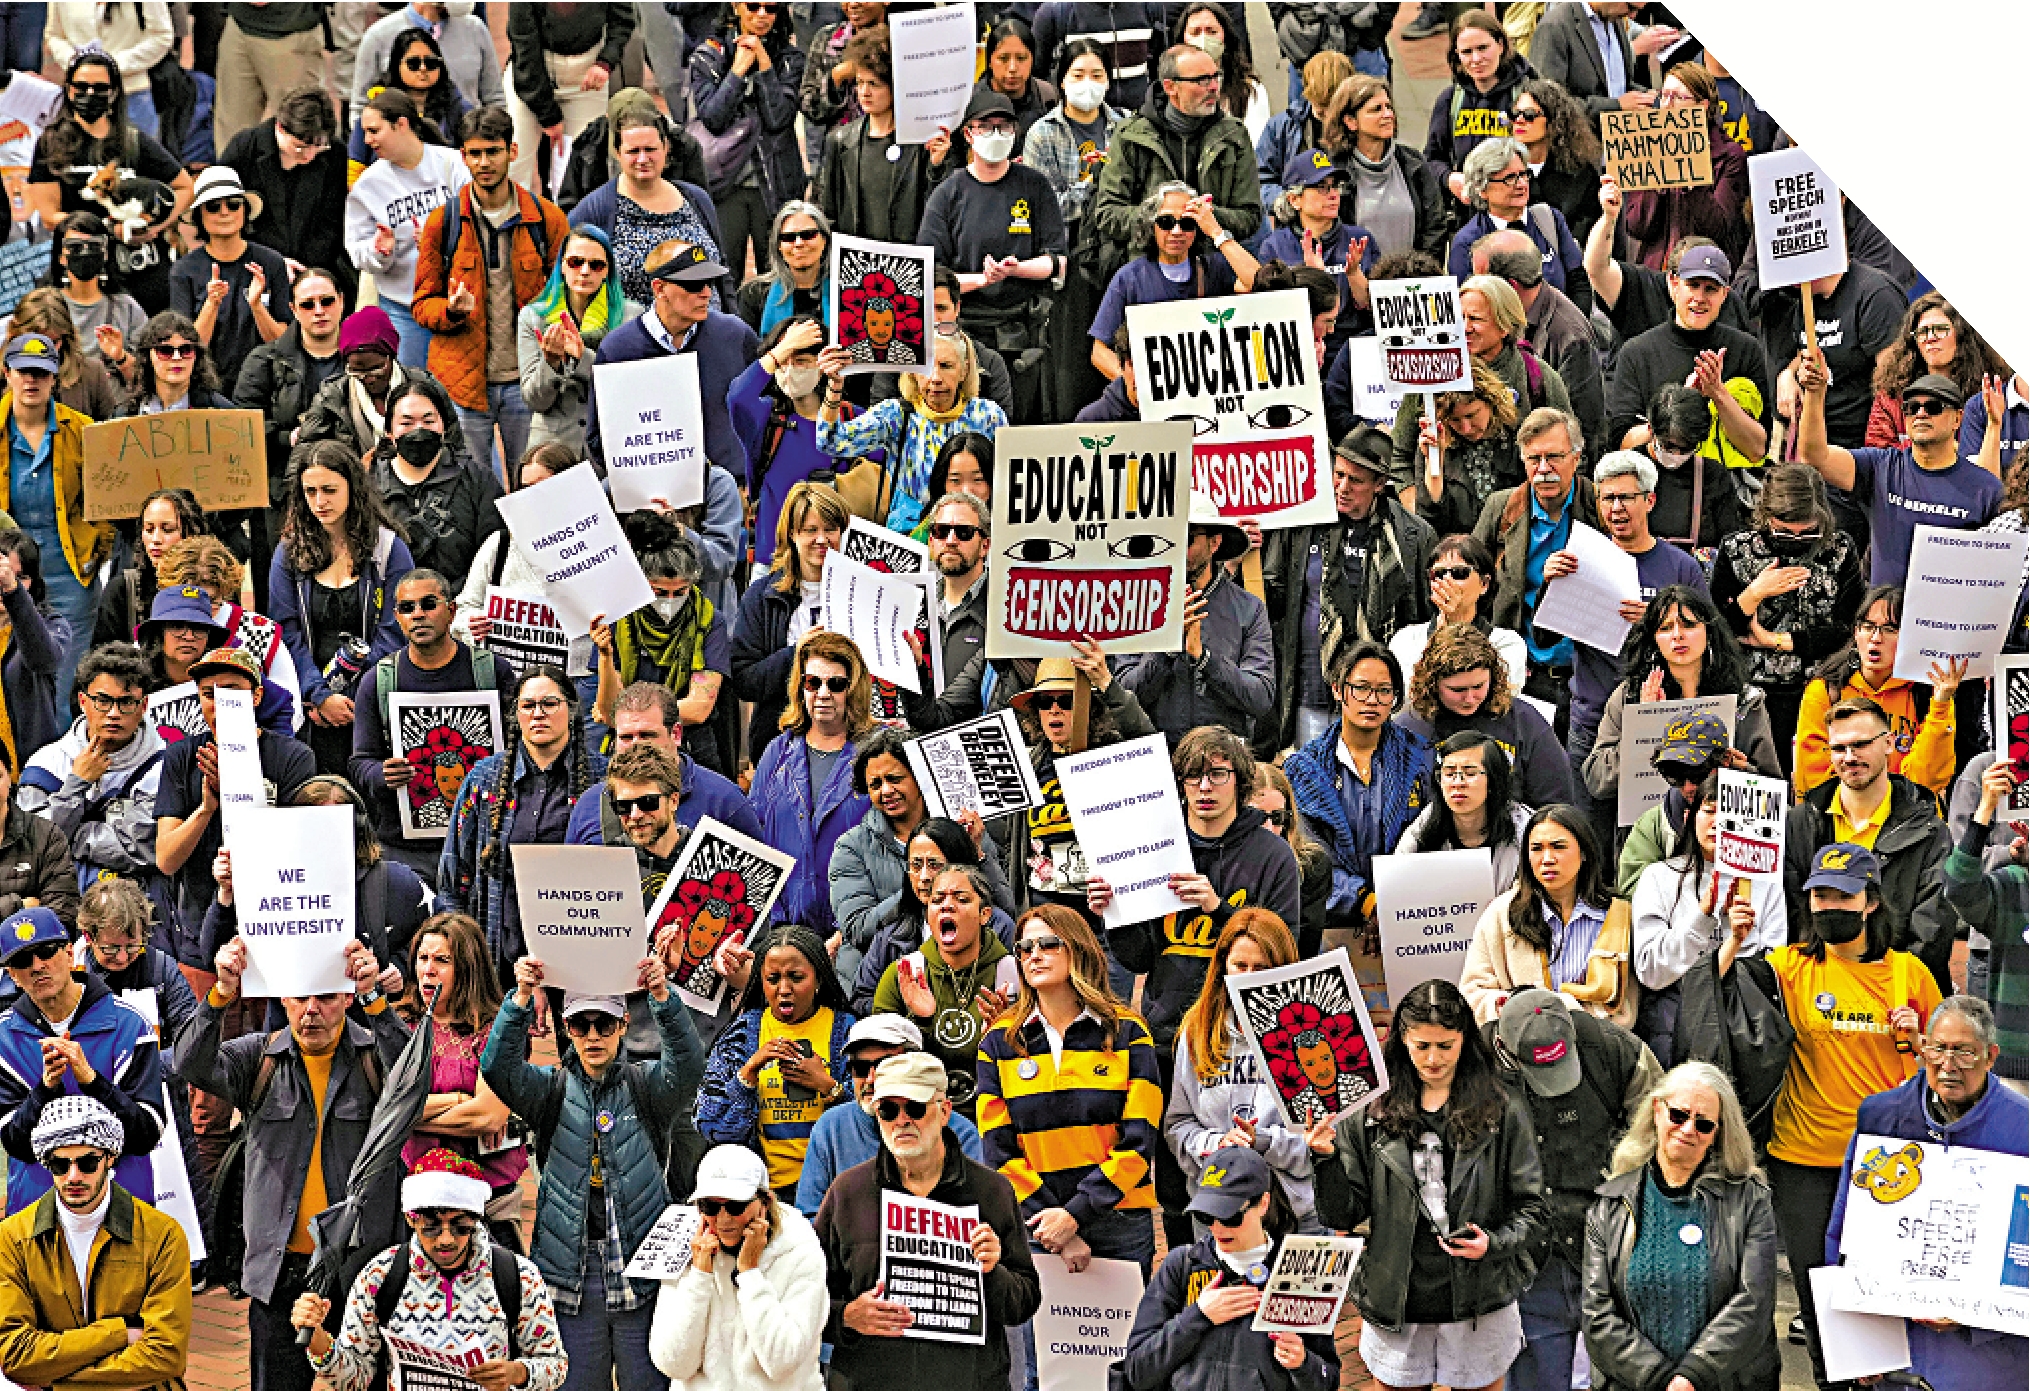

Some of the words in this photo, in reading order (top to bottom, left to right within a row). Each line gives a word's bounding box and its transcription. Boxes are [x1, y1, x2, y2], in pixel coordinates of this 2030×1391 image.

[1607, 108, 1704, 135] RELEASE
[1605, 131, 1705, 162] MAHMOUD
[1617, 157, 1705, 189] KHALIL
[1774, 171, 1816, 197] FREE
[1768, 187, 1824, 215] SPEECH
[1770, 228, 1829, 256] BERKELEY
[1376, 291, 1456, 329] EDUCATION
[1411, 327, 1426, 337] NOT
[1143, 318, 1306, 402] EDUCATION
[1388, 353, 1463, 381] CENSORSHIP
[1213, 394, 1245, 414] NOT
[638, 408, 662, 424] WE
[118, 416, 255, 463] ABOLISH
[624, 432, 654, 448] ARE
[655, 428, 684, 444] THE
[612, 446, 696, 468] UNIVERSITY
[1006, 451, 1178, 525] EDUCATION
[1192, 449, 1311, 509] NSORSHIP
[1888, 492, 1903, 506] UC
[1903, 498, 1969, 519] BERKELEY
[532, 526, 576, 552] HANDS
[575, 512, 600, 533] OFF
[1073, 521, 1109, 542] NOT
[1927, 534, 1971, 549] FREEDOM
[1971, 539, 1983, 549] TO
[1983, 540, 2012, 551] SPEAK
[559, 540, 590, 560] OUR
[545, 544, 619, 583] COMMUNITY
[1921, 574, 1963, 587] FREEDOM
[1965, 579, 1977, 588] TO
[1977, 579, 2007, 589] TEACH
[487, 594, 563, 630] DEFEN
[1009, 577, 1163, 633] CENSORSHIP
[1915, 617, 1957, 632] FREEDOM
[1959, 622, 1971, 632] TO
[1971, 623, 1999, 632] LEARN
[1919, 648, 1939, 658] FOR
[957, 731, 1005, 810] BERKELEY
[975, 725, 1027, 805] DEFEND
[1070, 755, 1112, 775] FREEDOM
[1112, 752, 1126, 764] TO
[1125, 745, 1154, 761] SPEAK
[1080, 799, 1122, 818] FREEDOM
[1122, 796, 1137, 809] TO
[1136, 789, 1165, 804] TEACH
[1720, 783, 1783, 822] EDUCATION
[1095, 848, 1136, 866] FREEDOM
[1137, 844, 1150, 856] TO
[1150, 837, 1176, 853] LEARN
[1719, 835, 1778, 873] CENSORSHIP
[1818, 848, 1853, 871] Cal
[277, 867, 307, 885] WE
[258, 896, 295, 912] ARE
[296, 894, 333, 911] THE
[537, 888, 593, 902] HANDS
[595, 890, 624, 902] OFF
[566, 906, 601, 920] OUR
[1395, 906, 1448, 922] HANDS
[1450, 902, 1478, 917] OFF
[244, 918, 345, 936] UNIVERSITY
[537, 924, 633, 938] COMMUNITY
[1422, 922, 1455, 937] OUR
[1395, 938, 1474, 958] COMMUNI
[1822, 1009, 1844, 1023] WE
[1847, 1011, 1875, 1025] ARE
[1831, 1020, 1891, 1035] BERKELE
[1929, 1199, 1982, 1221] FREE
[887, 1201, 979, 1244] DEFEND
[1896, 1216, 1977, 1245] SPEECH
[885, 1233, 979, 1267] EDUCATION
[1921, 1243, 1973, 1265] FREE
[1278, 1249, 1353, 1277] EDUCATION
[889, 1278, 935, 1295] FREEDOM
[935, 1284, 949, 1297] TO
[891, 1265, 935, 1281] FREEDOM
[935, 1271, 949, 1283] TO
[949, 1273, 977, 1288] SPEAK
[935, 1298, 949, 1312] TO
[1050, 1304, 1102, 1319] HANDS
[1104, 1308, 1132, 1321] OFF
[1263, 1296, 1334, 1325] CENSORSHIP
[1078, 1324, 1110, 1338] OUR
